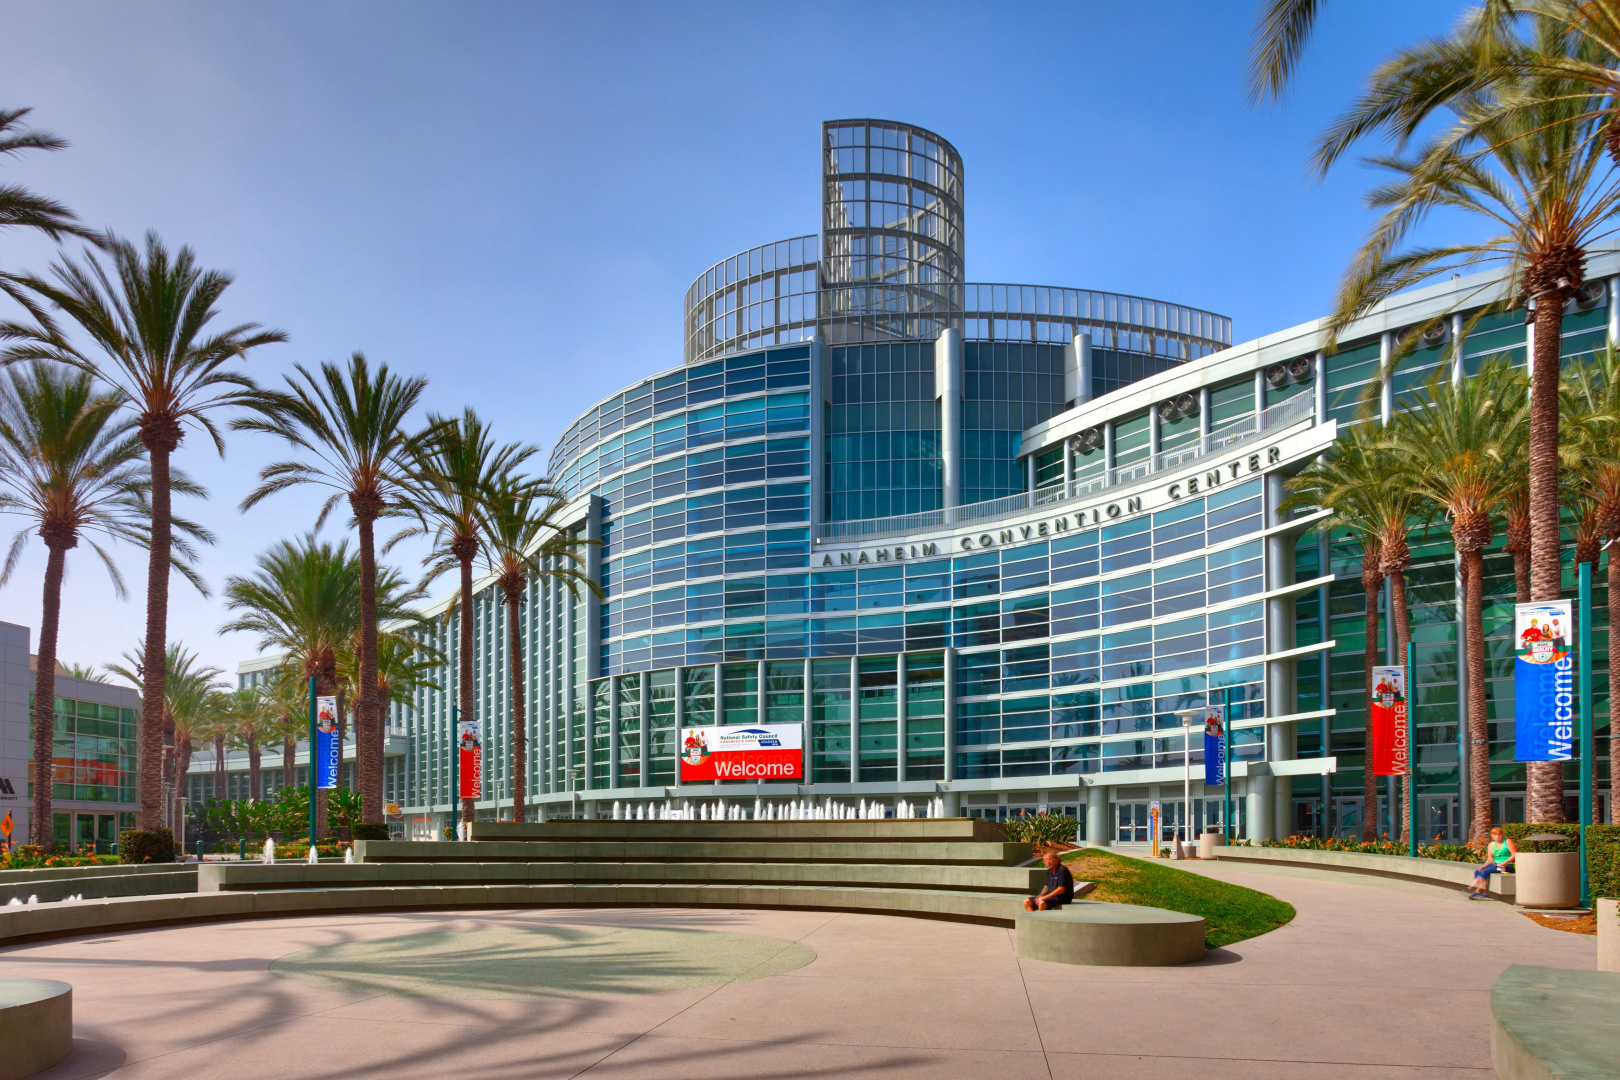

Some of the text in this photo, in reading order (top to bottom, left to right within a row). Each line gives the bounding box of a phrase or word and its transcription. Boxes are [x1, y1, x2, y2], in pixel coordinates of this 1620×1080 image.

[822, 445, 1280, 567] ANAHEIM CONVENTION CENTER
[1548, 656, 1572, 760] Welcome
[328, 729, 339, 787] Welcome
[1216, 734, 1225, 785] Welcome
[1392, 704, 1405, 774] Welcome
[472, 749, 480, 798] Welcome
[715, 761, 794, 776] Welcome
